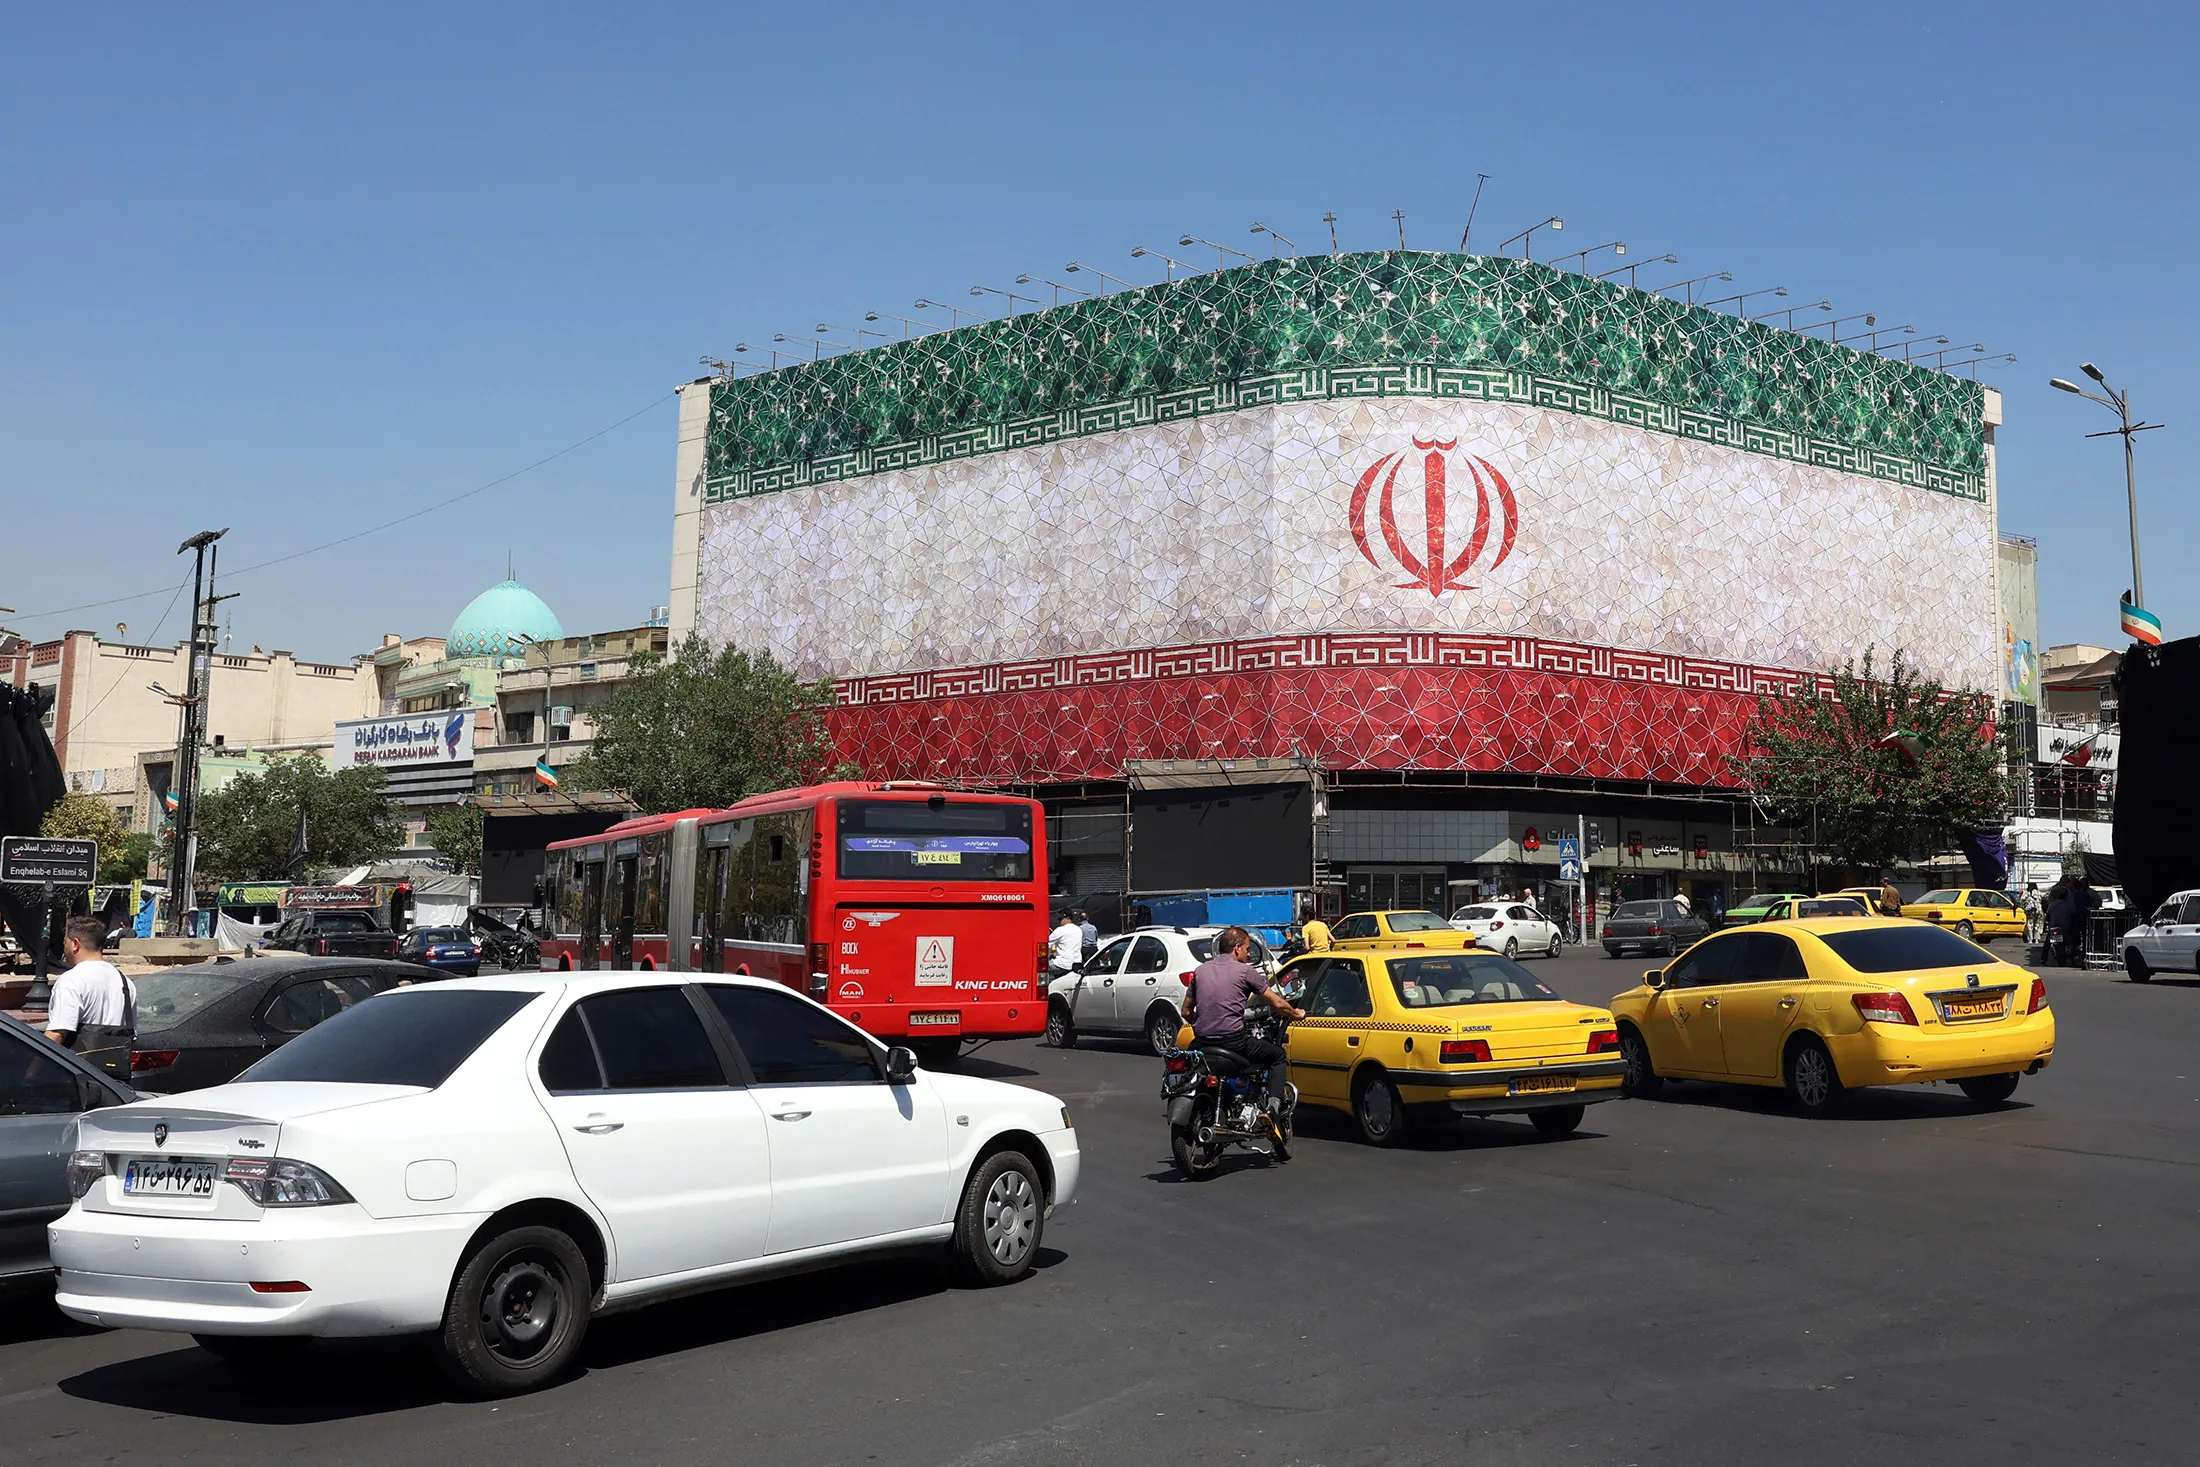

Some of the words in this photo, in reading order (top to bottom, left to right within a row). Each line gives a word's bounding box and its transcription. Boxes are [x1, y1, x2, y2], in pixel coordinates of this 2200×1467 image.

[418, 745, 440, 759] BANK
[41, 844, 65, 854] انقلاب
[66, 845, 88, 855] میدان
[10, 867, 51, 877] Enqhelab-e
[53, 868, 77, 876] Eslami
[78, 868, 88, 879] Sq
[955, 981, 988, 990] KING
[990, 981, 1028, 990] LONG
